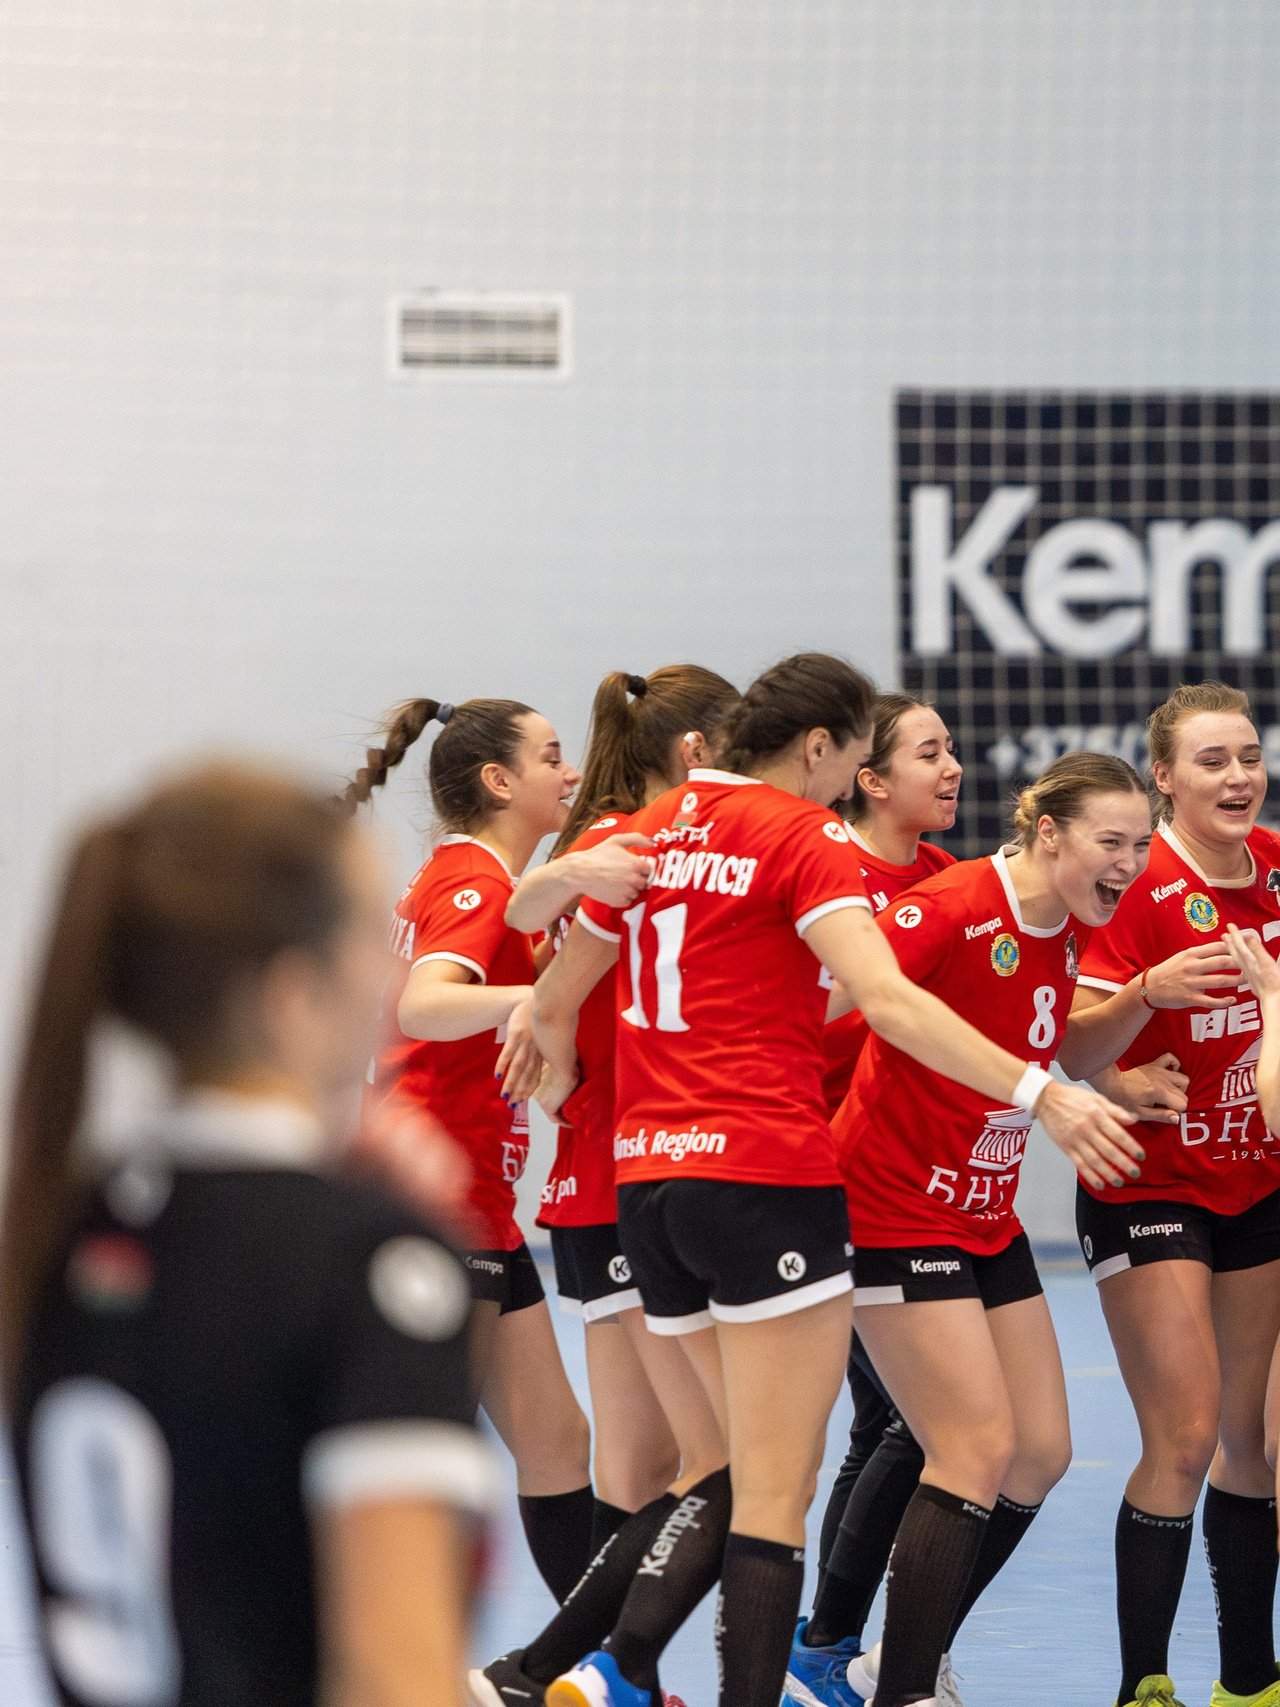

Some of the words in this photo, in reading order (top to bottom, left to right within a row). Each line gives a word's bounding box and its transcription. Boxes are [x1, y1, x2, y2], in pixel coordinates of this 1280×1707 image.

[1150, 877, 1188, 903] Kempa
[964, 917, 1003, 940] Kempa
[620, 901, 691, 1032] 11
[1028, 985, 1057, 1049] 8
[613, 1128, 649, 1162] insk
[650, 1126, 727, 1162] Region
[1129, 1223, 1183, 1239] Kempa
[910, 1259, 961, 1275] Kempa
[1131, 1511, 1193, 1530] Kemp
[637, 1495, 708, 1577] Kempa
